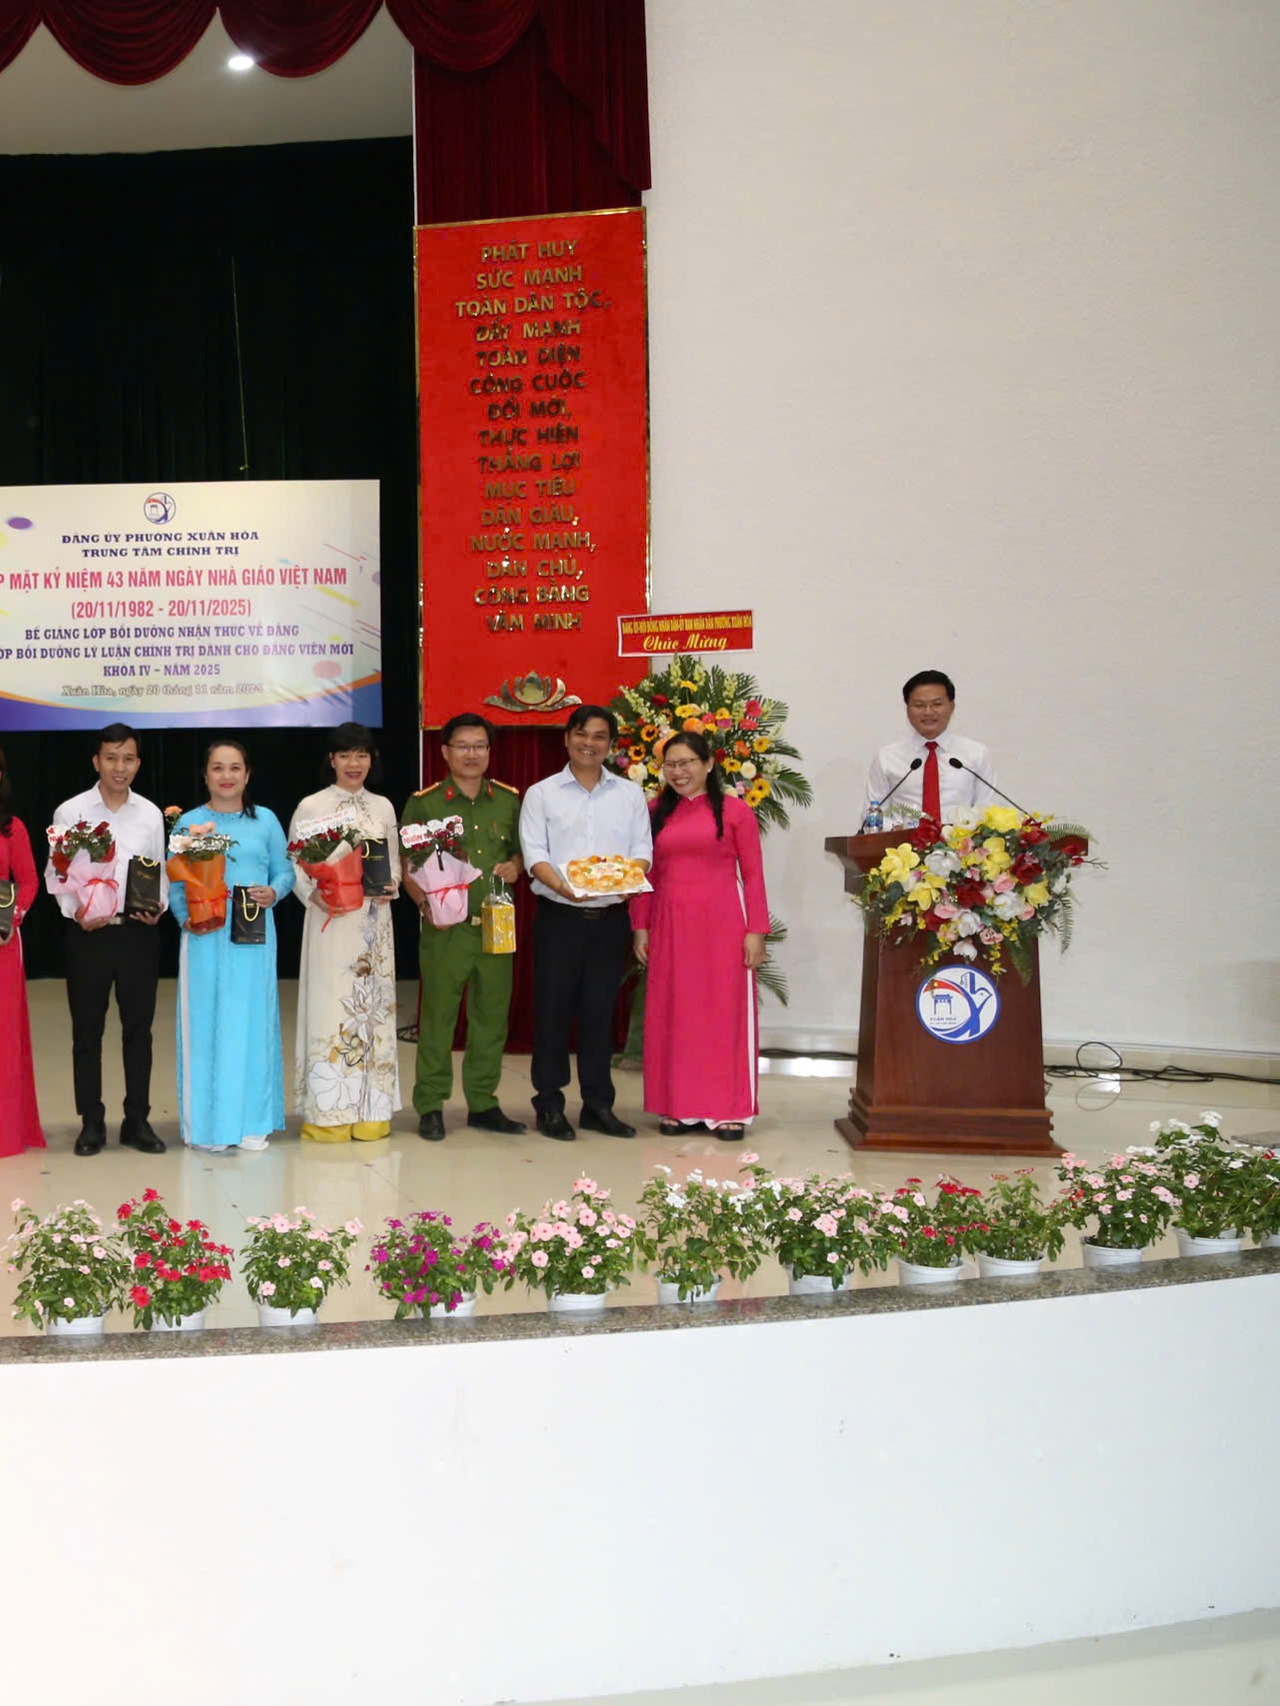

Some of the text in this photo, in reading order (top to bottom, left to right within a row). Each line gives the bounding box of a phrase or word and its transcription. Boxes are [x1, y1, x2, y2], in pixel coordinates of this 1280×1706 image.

[481, 240, 577, 263] PHÁT HUY
[477, 266, 583, 290] SỨC MẠNH
[455, 297, 506, 317] TOÀN
[514, 292, 554, 314] DÂN
[523, 319, 580, 343] MẠNH
[477, 345, 527, 367] TOÀN
[470, 369, 586, 395] CÔNG CUỘC
[537, 422, 579, 446] HIỆN
[485, 478, 574, 504] MỤC TIÊU
[482, 505, 520, 525] DÂN
[82, 549, 128, 557] TRUNG
[534, 532, 596, 553] MẠNH,
[487, 556, 527, 578] DÂN
[9, 569, 38, 593] MẶT
[44, 566, 61, 589] KỶ
[66, 568, 102, 592] NIỆM
[107, 572, 123, 588] 43
[128, 567, 161, 587] NĂM
[166, 565, 203, 586] NGÀY
[208, 565, 237, 586] NHÀ
[242, 565, 275, 585] GIÁO
[279, 565, 308, 589] VIỆT
[314, 568, 347, 584] NAM
[474, 584, 529, 605] CÔNG
[72, 600, 153, 620] (20/11/1982
[168, 599, 251, 616] 20/11/2025)
[534, 613, 582, 630] MINH
[235, 645, 259, 656] CHO
[643, 633, 727, 650] Chúc Mừng
[139, 665, 150, 676] IV
[194, 664, 220, 675] 2025
